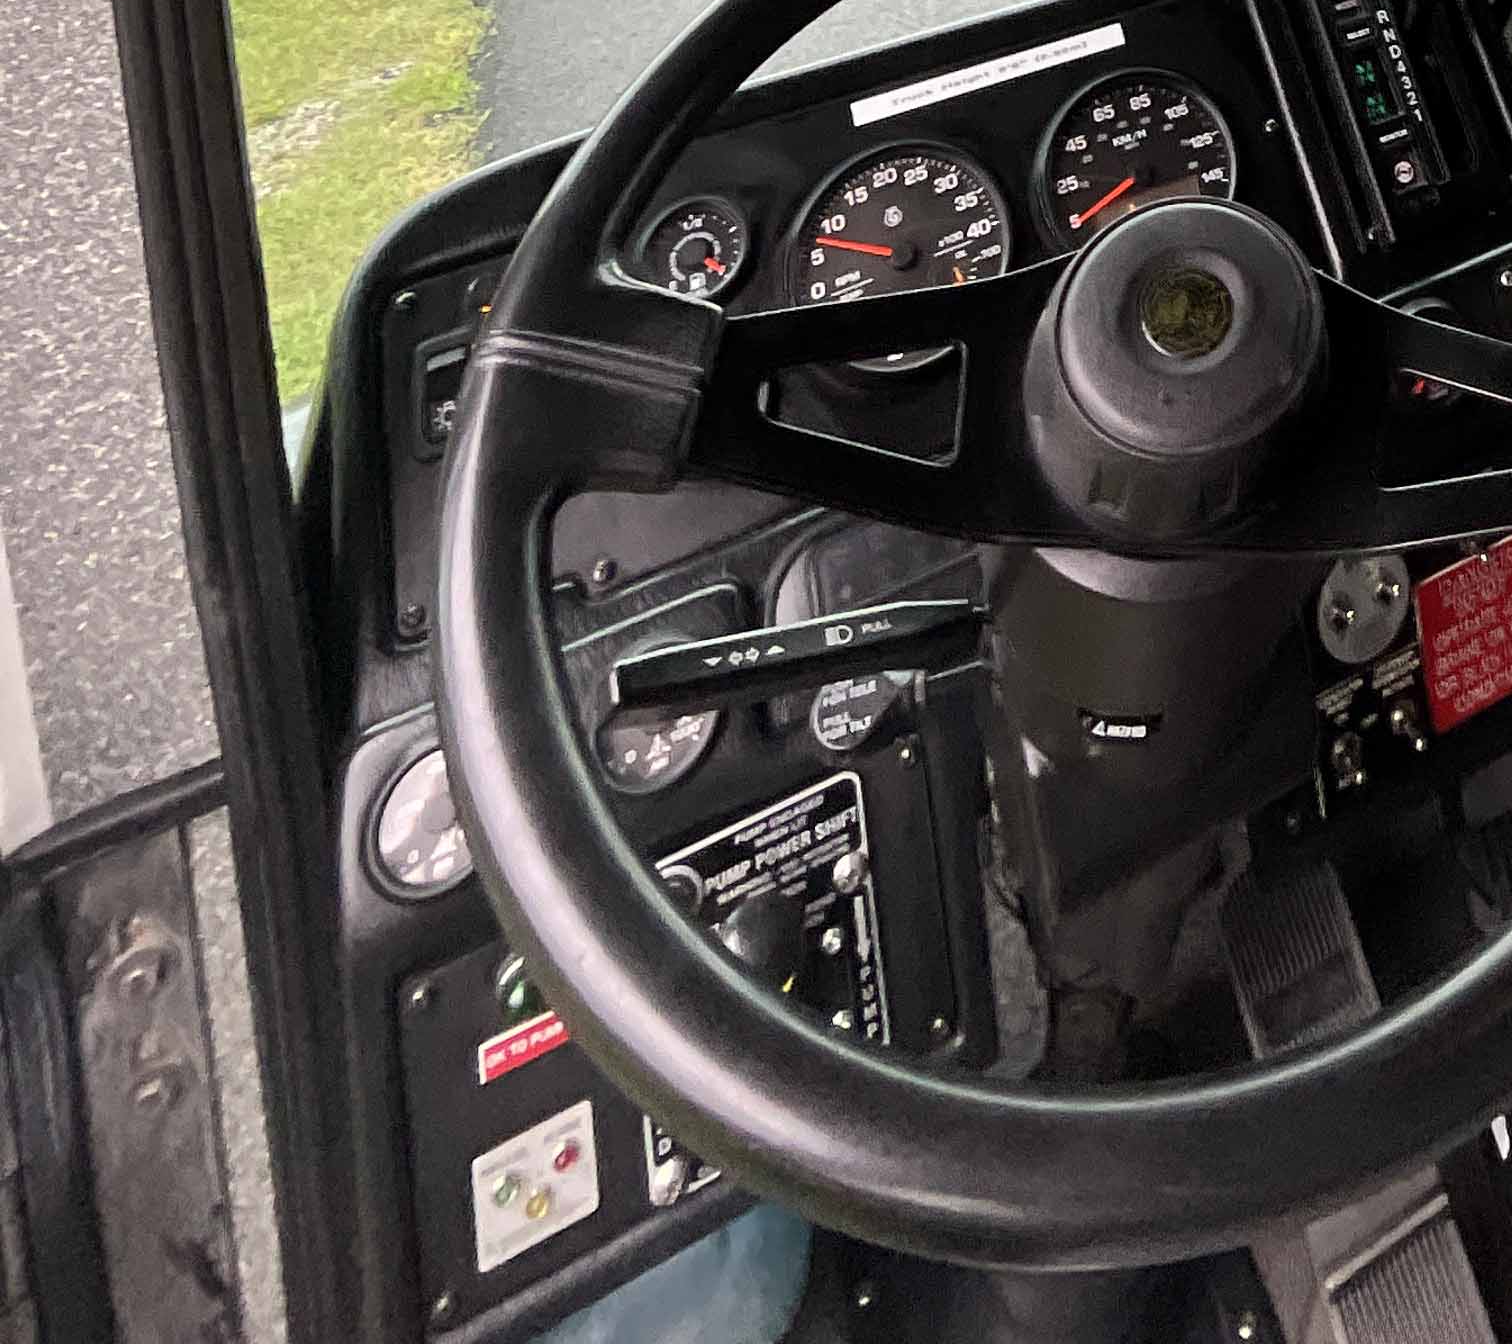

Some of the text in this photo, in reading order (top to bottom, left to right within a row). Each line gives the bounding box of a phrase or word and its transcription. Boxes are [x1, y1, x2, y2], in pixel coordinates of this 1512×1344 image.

[1376, 10, 1423, 122] R N D 4 3 2 1
[1129, 93, 1151, 111] 85
[1093, 105, 1115, 122] 65
[1065, 135, 1087, 152] 45
[1112, 129, 1147, 147] KM/H
[872, 168, 897, 188] 20
[903, 165, 928, 186] 25
[933, 173, 958, 193] 30
[1057, 175, 1079, 194] 25
[844, 187, 868, 206] 15
[954, 192, 978, 212] 35
[820, 215, 846, 234] 10
[966, 218, 991, 238] 40
[810, 248, 825, 266] 5
[810, 282, 826, 300] 0
[704, 860, 751, 895] PUMP
[754, 830, 811, 870] POWER
[814, 805, 858, 840] SHIFT
